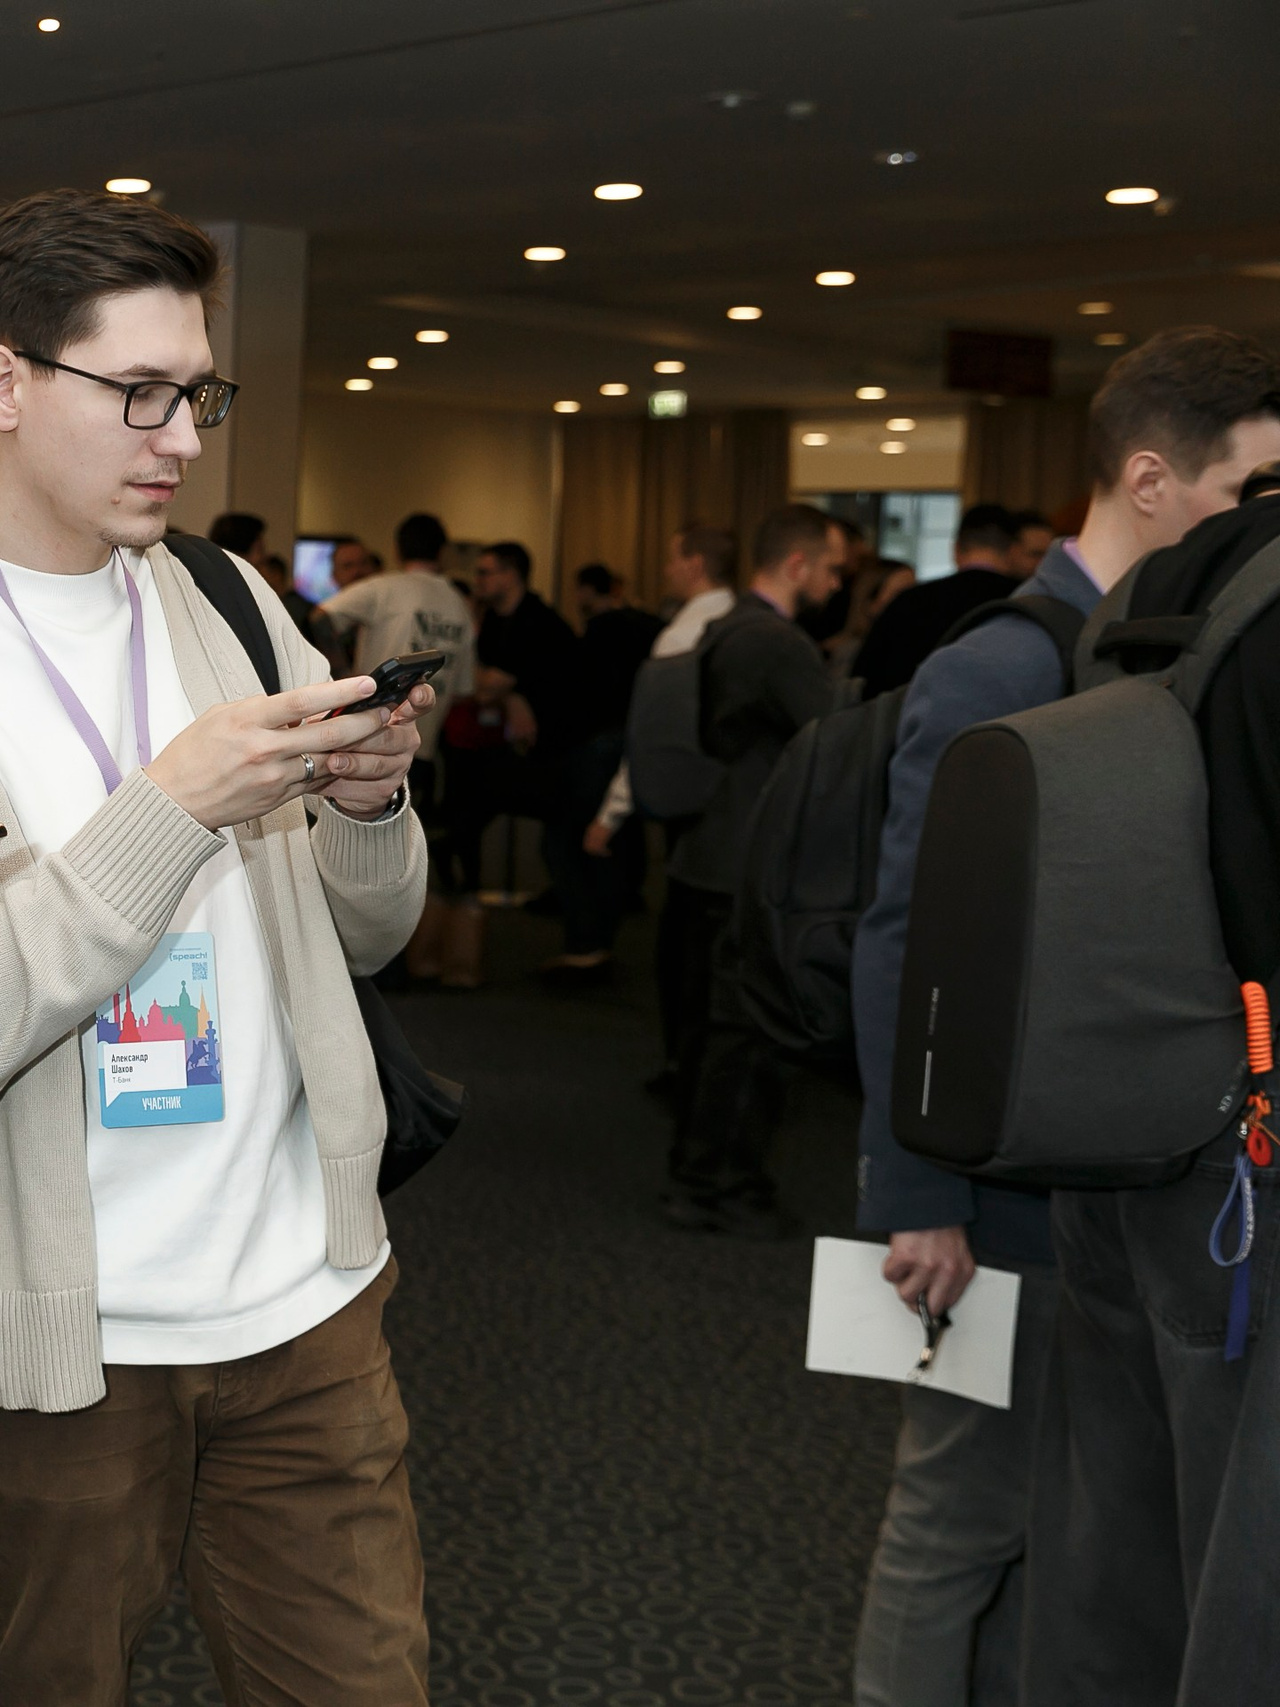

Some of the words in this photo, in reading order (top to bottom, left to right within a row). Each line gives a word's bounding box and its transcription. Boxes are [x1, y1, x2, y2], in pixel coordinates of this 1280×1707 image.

[111, 1053, 149, 1063] Александр
[111, 1065, 134, 1074] Шахов
[141, 1095, 182, 1111] УЧАСТНИК
